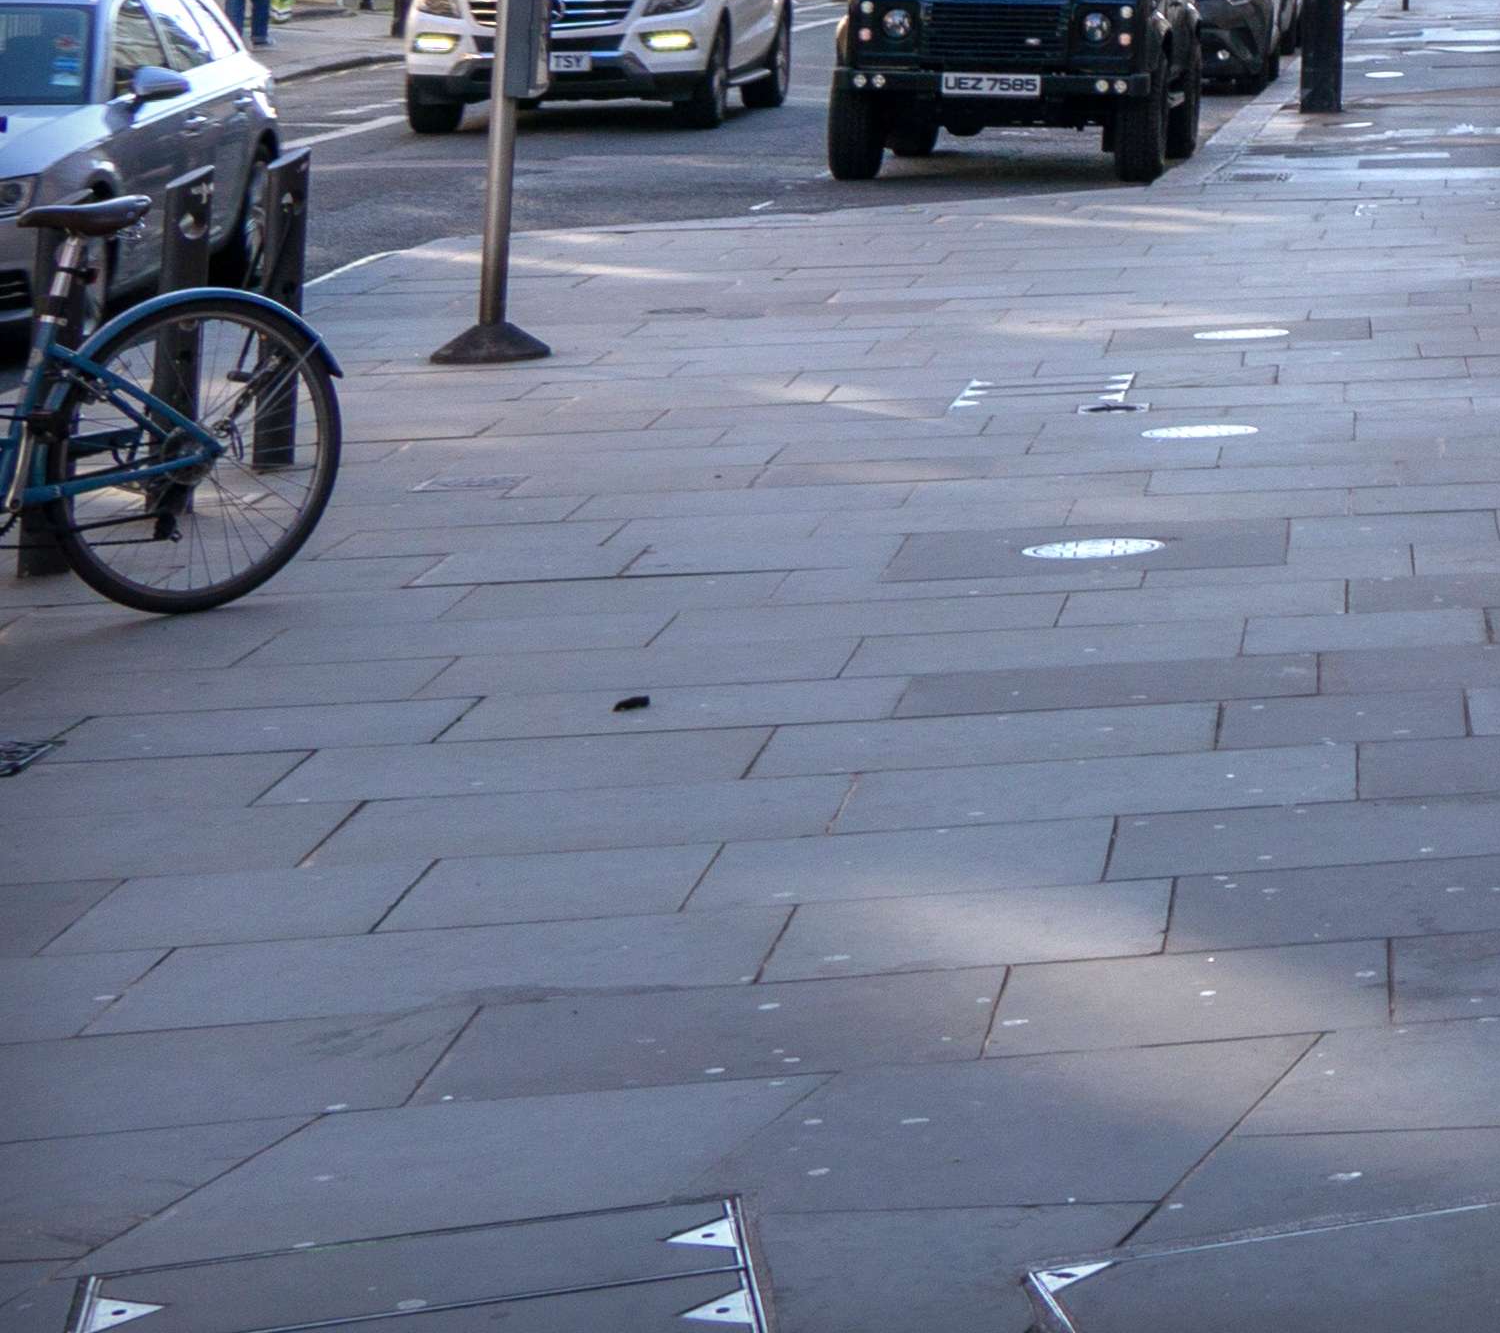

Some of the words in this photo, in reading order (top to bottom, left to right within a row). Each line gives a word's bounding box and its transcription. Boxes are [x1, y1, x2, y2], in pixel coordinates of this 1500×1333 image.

[553, 54, 585, 69] TSY
[944, 76, 983, 90] UEZ
[986, 77, 1038, 92] 7585
